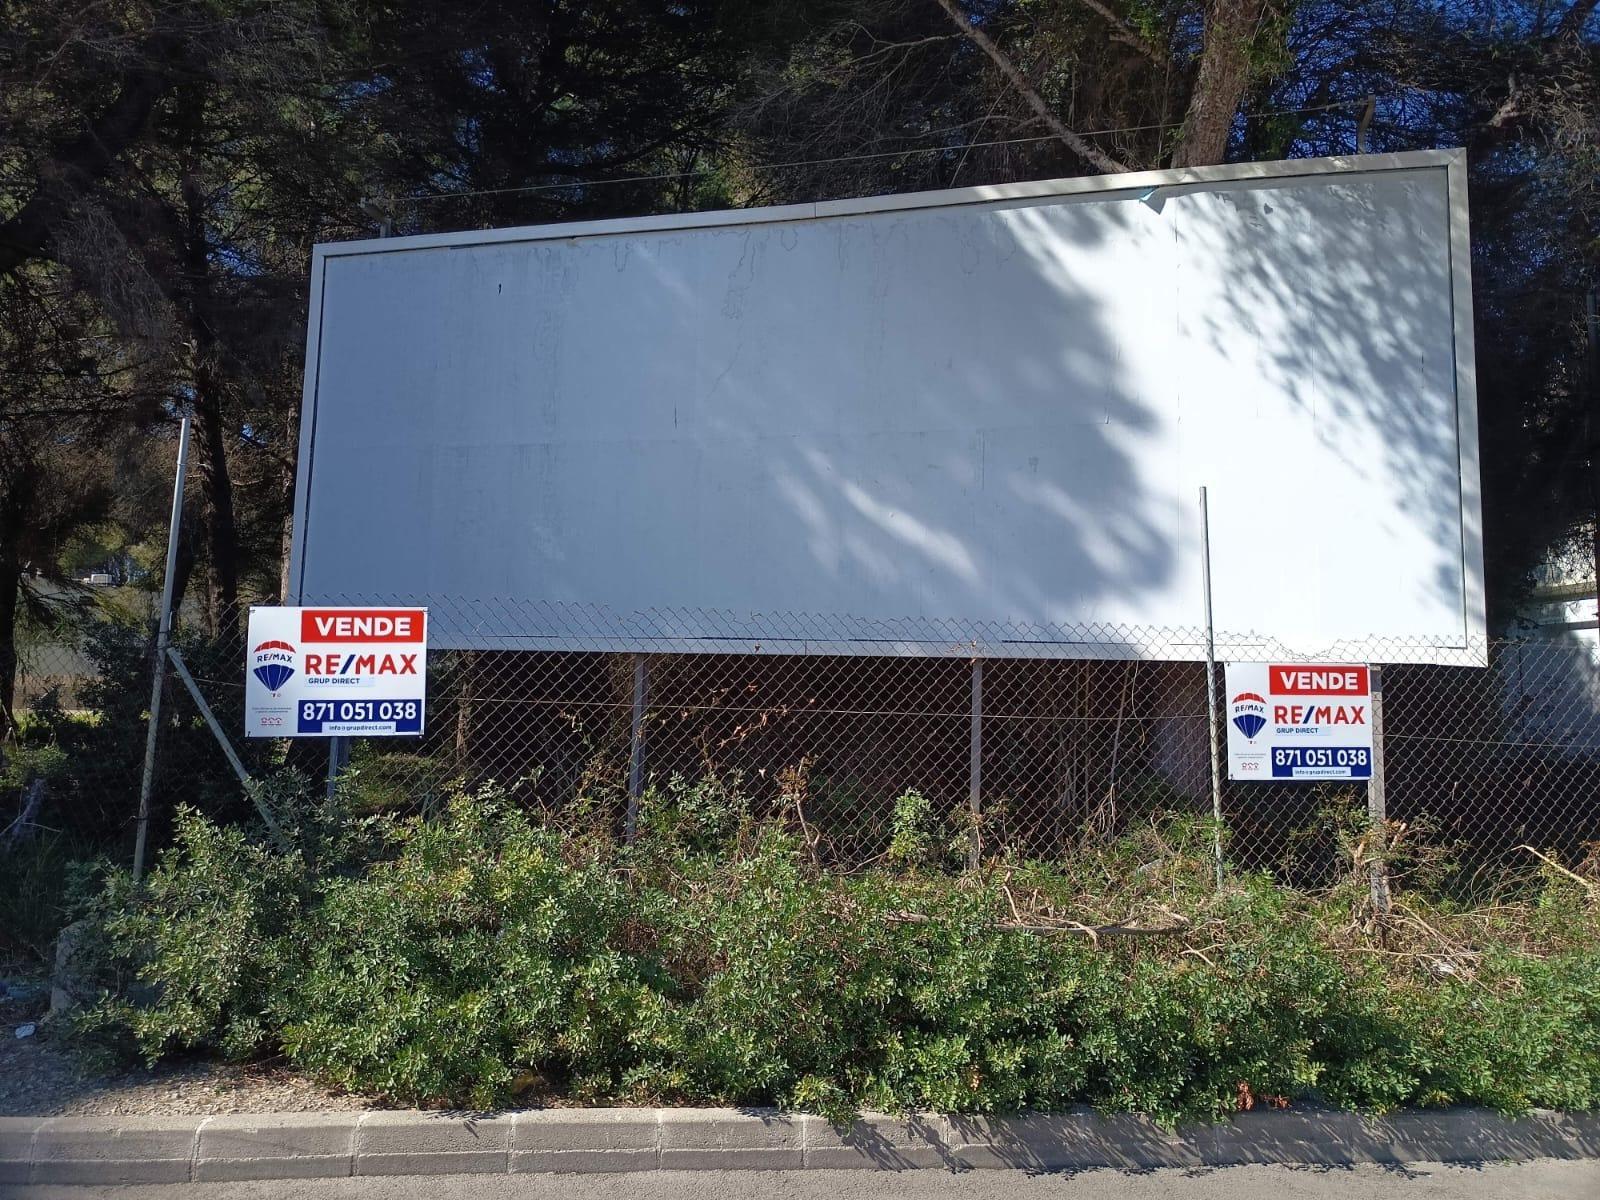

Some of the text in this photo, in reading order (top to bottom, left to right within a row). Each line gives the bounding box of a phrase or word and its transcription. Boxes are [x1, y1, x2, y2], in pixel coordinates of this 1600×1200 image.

[314, 616, 411, 637] VENDE
[256, 653, 293, 664] RE/MAX
[304, 654, 417, 675] RE/MAX
[1280, 671, 1358, 690] VENDE
[303, 702, 417, 720] 871 051 038
[1235, 704, 1265, 713] RE/MAX
[1274, 705, 1366, 725] RE/MAX
[1275, 749, 1301, 766] 871
[1305, 749, 1333, 766] 051
[1337, 749, 1367, 766] 038
